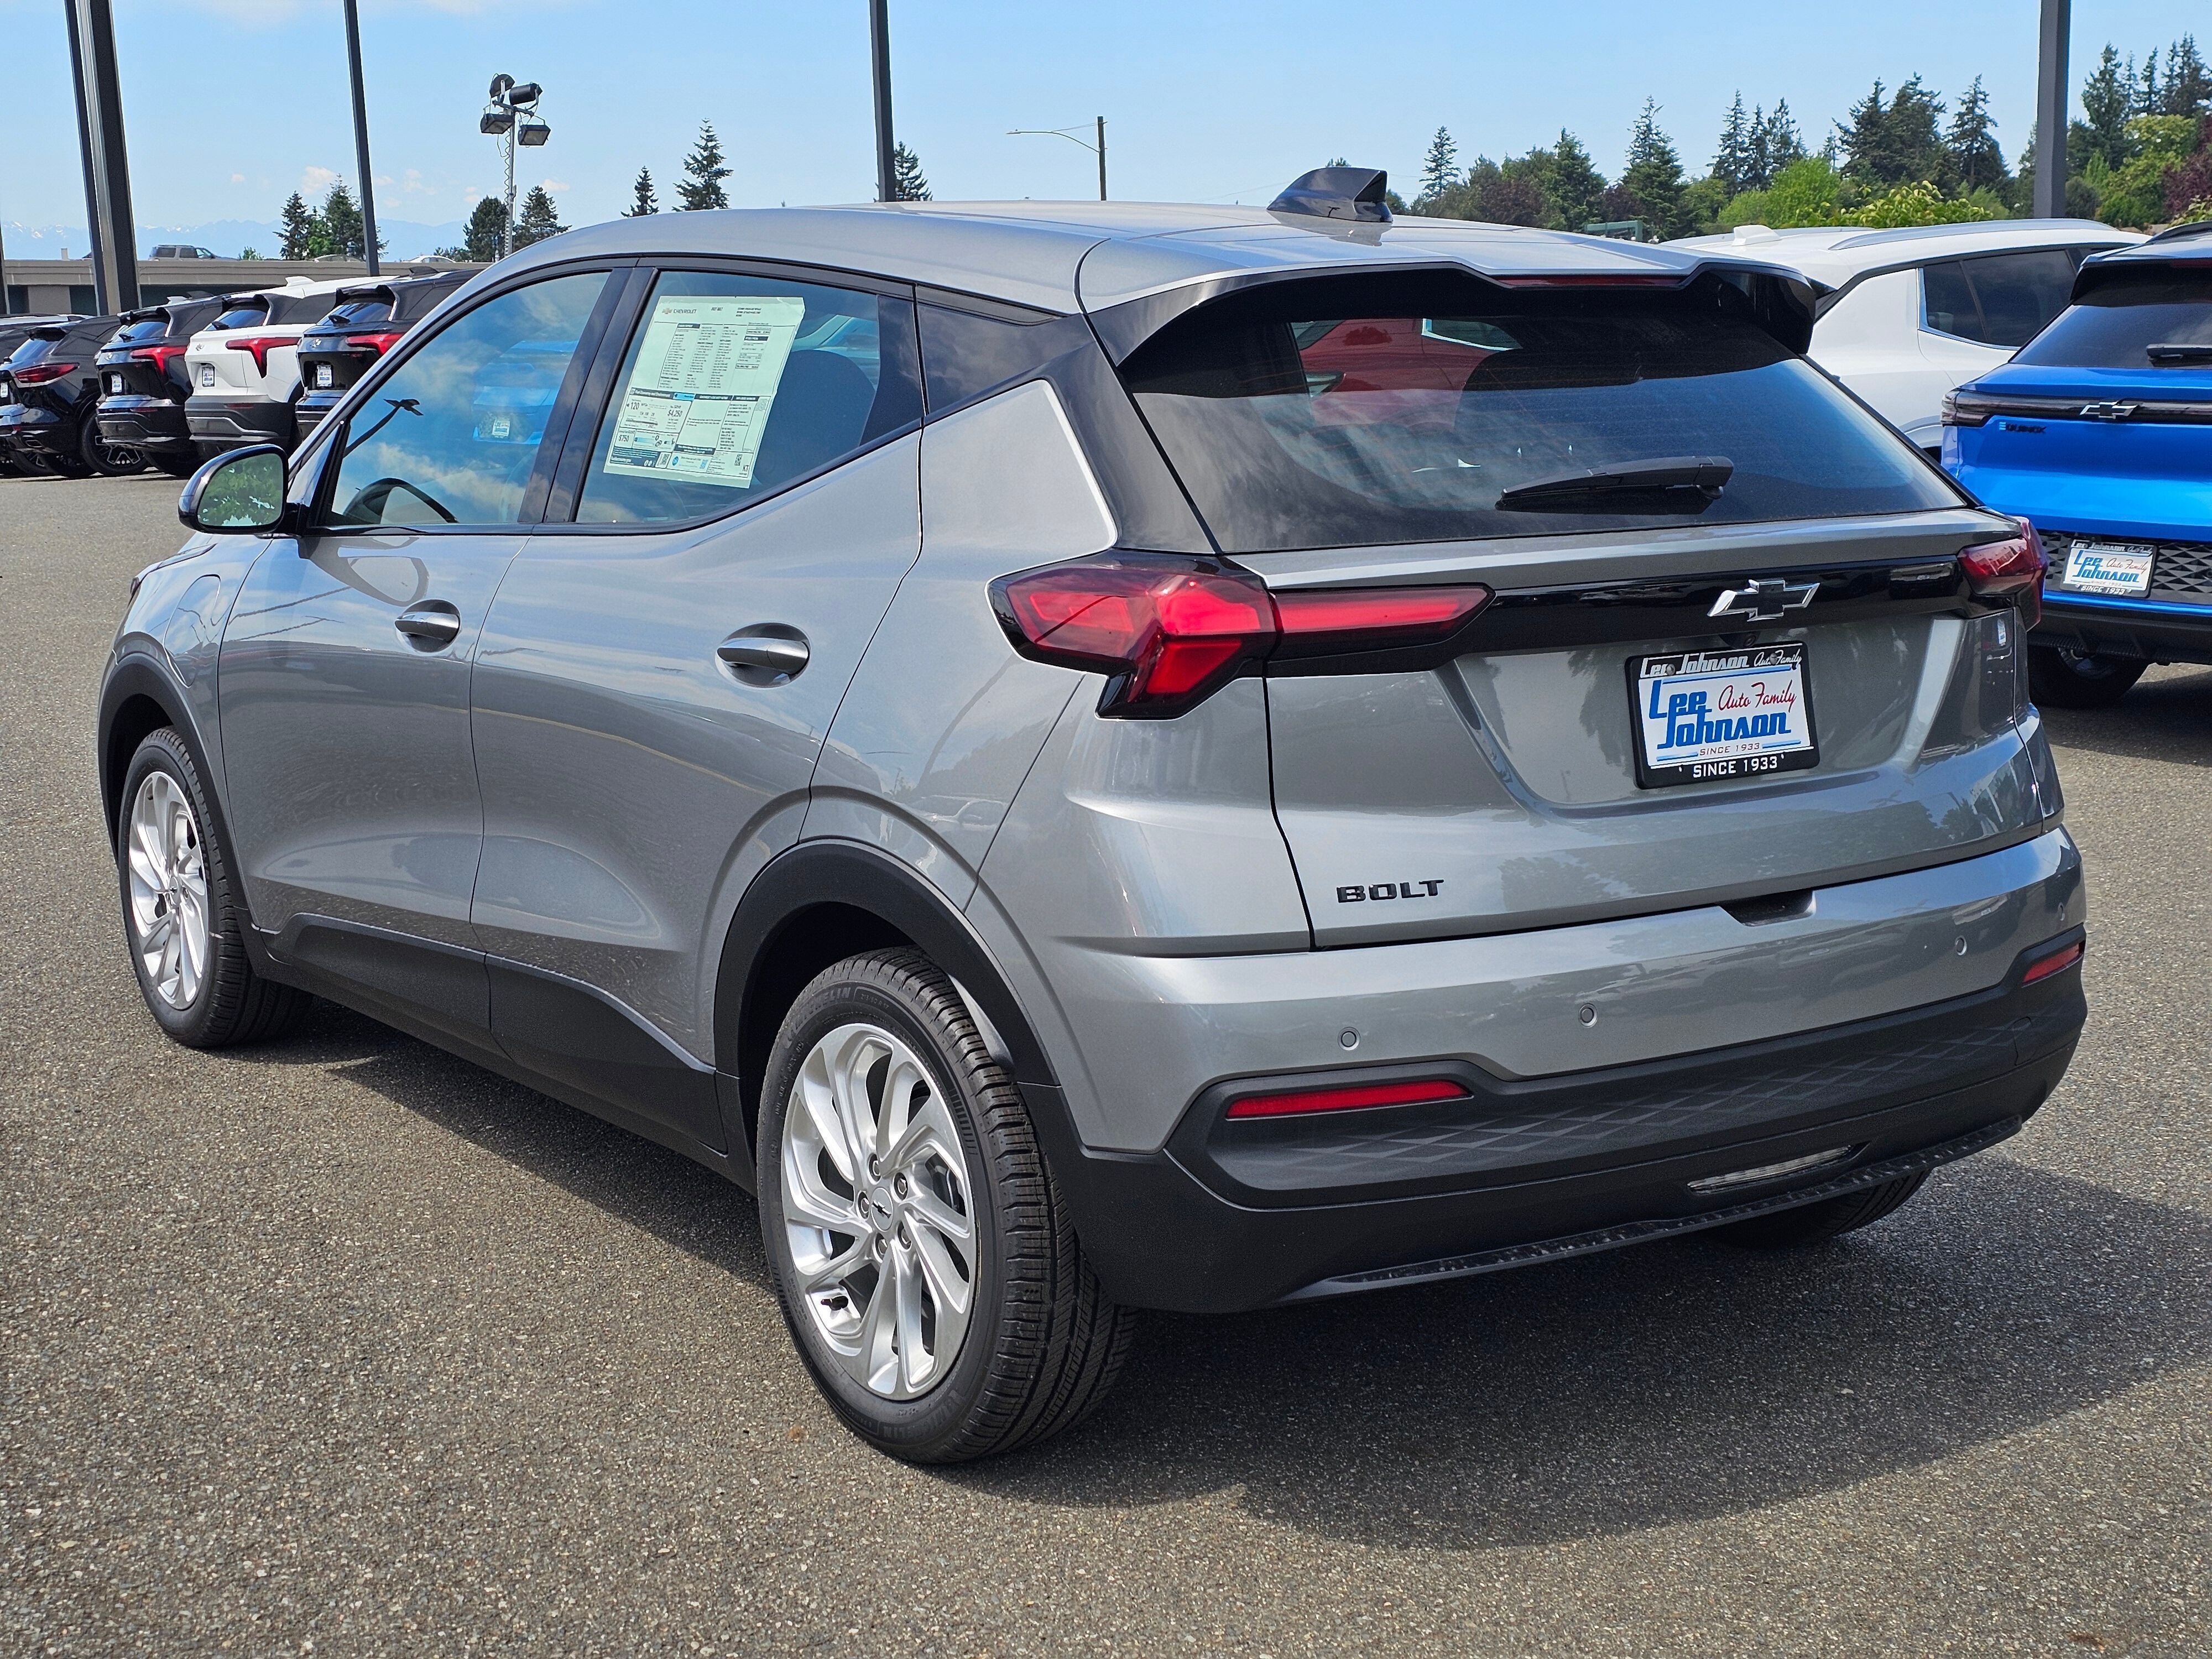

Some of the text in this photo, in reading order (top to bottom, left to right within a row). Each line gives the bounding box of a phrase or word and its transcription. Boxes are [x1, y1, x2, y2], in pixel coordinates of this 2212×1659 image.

[2074, 550, 2103, 567] Lee
[2106, 557, 2148, 575] Auto Family
[2072, 563, 2140, 583] Johnson
[2105, 587, 2126, 596] 1933
[1676, 653, 1750, 674] Johnson
[1649, 680, 1712, 719] Lee
[1718, 680, 1797, 713] Auto Family
[1657, 704, 1792, 749] Johnson
[1699, 743, 1760, 755] SINCE 1933
[1693, 756, 1778, 778] SINCE 1933
[1336, 879, 1444, 903] BOLT
